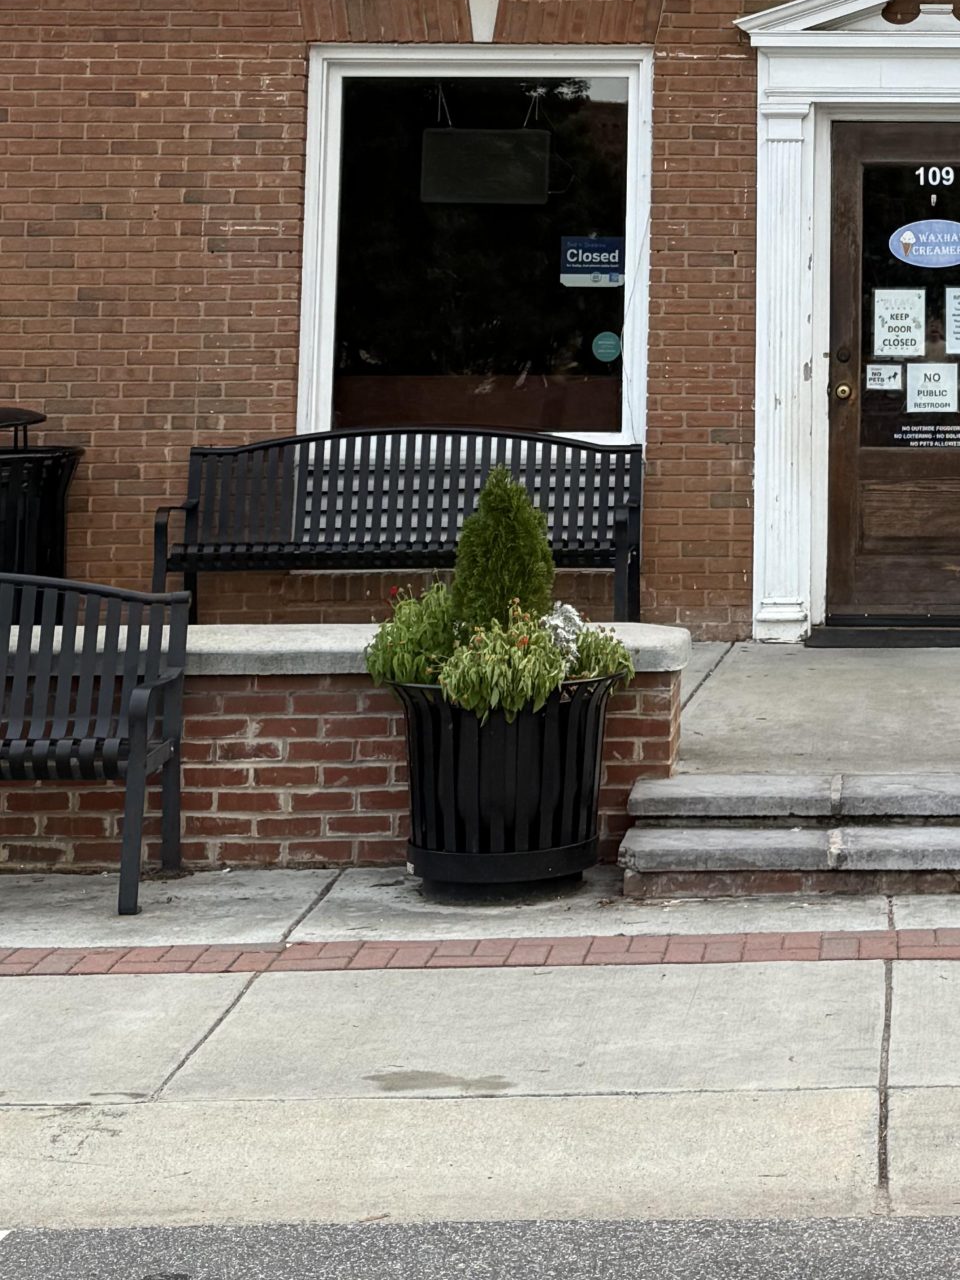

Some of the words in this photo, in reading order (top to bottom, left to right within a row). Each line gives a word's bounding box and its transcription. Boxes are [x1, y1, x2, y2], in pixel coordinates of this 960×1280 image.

[915, 166, 955, 186] 109
[566, 248, 619, 263] Closed
[889, 313, 910, 321] KEEP
[887, 325, 912, 333] DOOR
[882, 338, 917, 347] CLOSED
[923, 372, 941, 382] NO
[917, 389, 948, 397] PUBLIC
